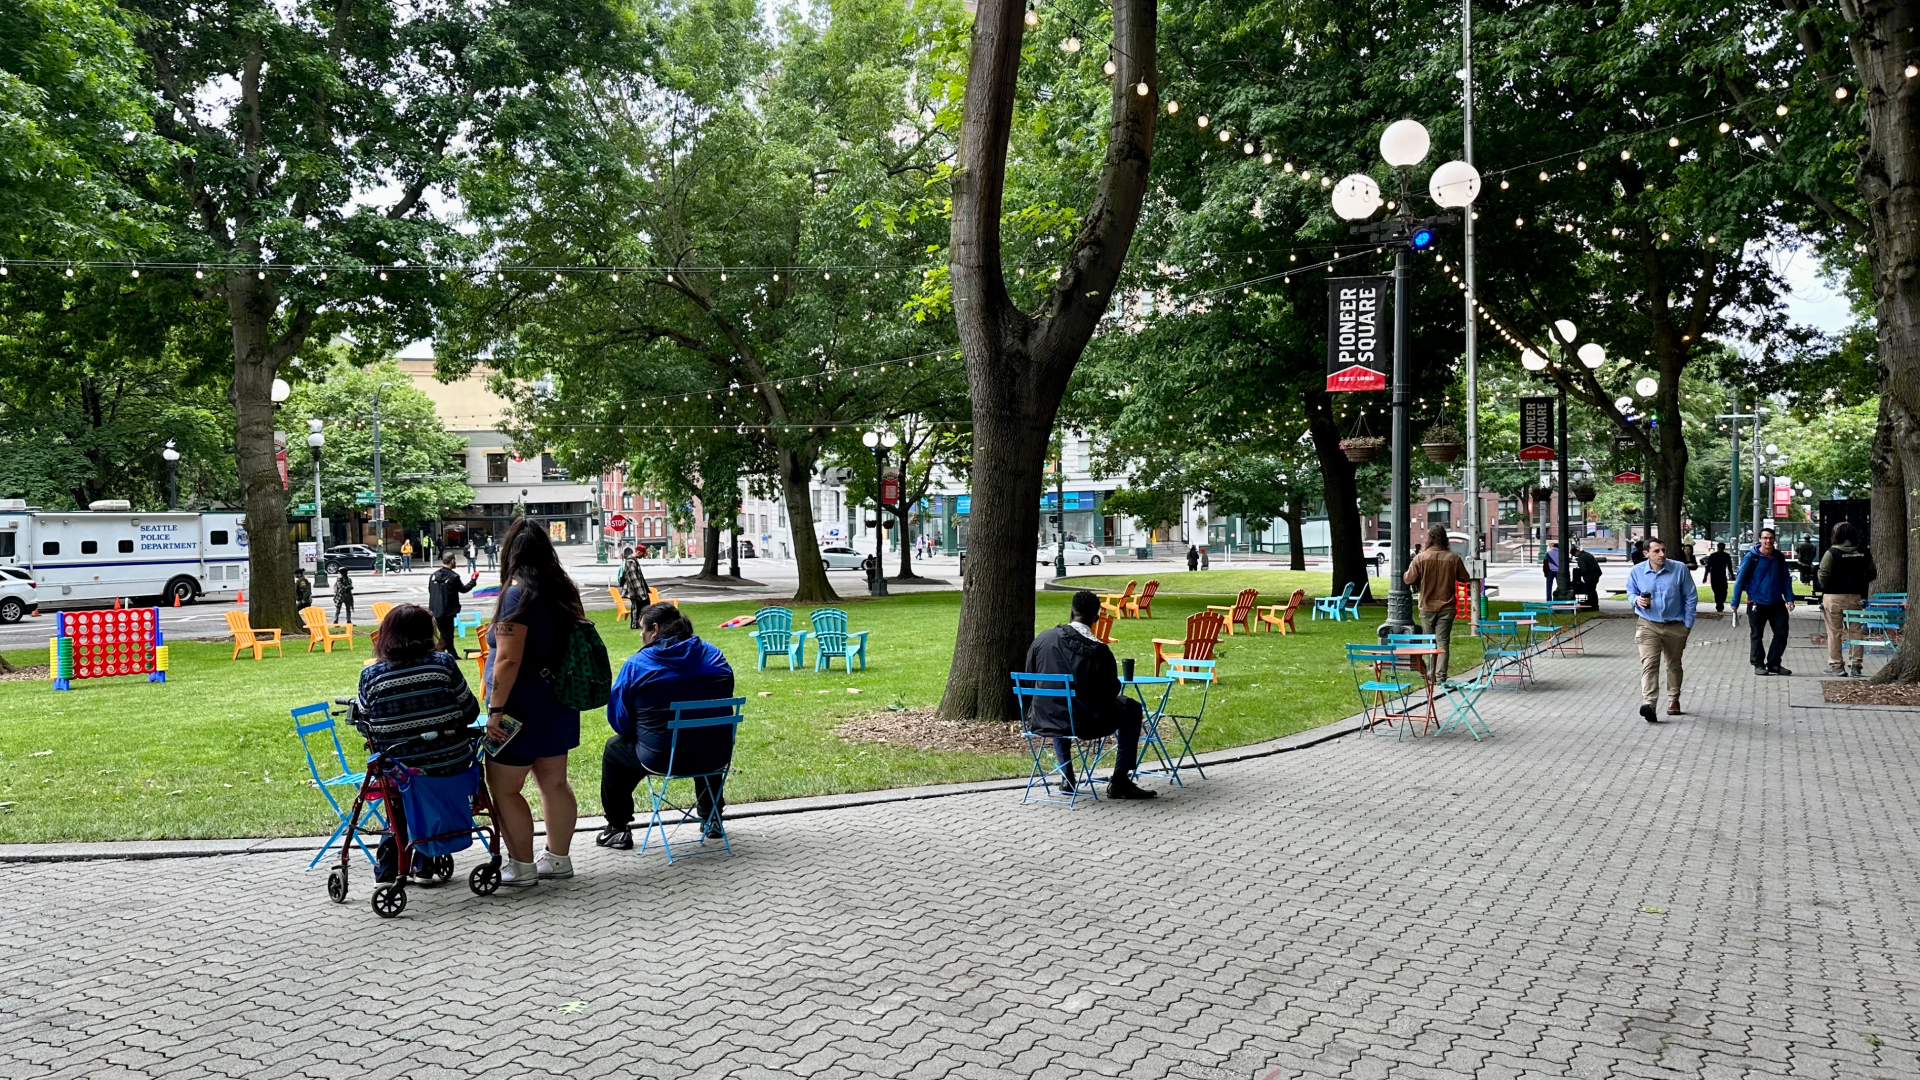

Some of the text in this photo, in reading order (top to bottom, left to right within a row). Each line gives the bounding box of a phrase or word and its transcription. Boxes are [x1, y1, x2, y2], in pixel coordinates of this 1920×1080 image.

[1338, 287, 1357, 363] PIONEER
[1357, 287, 1377, 362] SQUARE
[1525, 403, 1536, 444] PIONEER
[1537, 403, 1548, 443] SQUARE
[611, 519, 626, 528] STOP
[141, 542, 197, 550] DEPARTMENT
